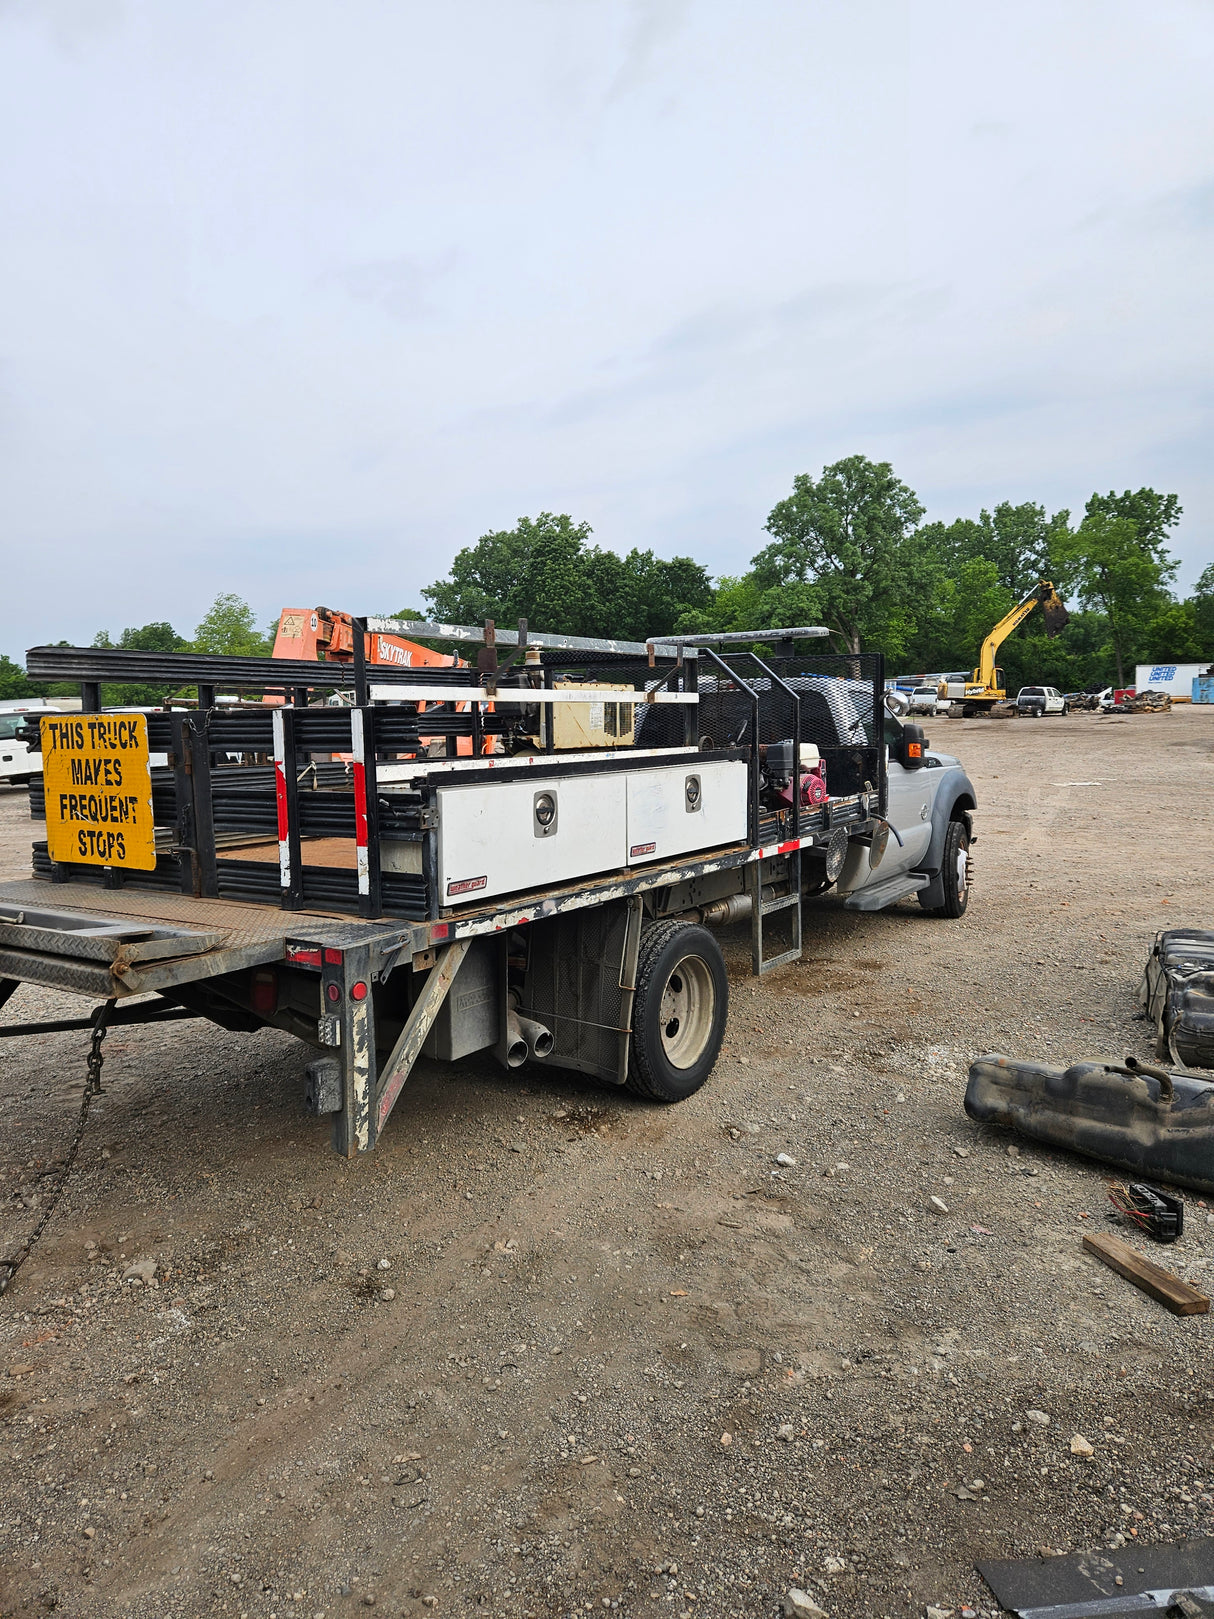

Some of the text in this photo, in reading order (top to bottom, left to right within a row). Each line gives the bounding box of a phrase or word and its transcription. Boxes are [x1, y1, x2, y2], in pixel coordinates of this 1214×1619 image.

[380, 642, 412, 667] SKYTRAK
[49, 720, 139, 750] THIS TRUCK
[71, 758, 122, 787] MAKES
[59, 793, 139, 825] FREQUENT
[78, 829, 126, 860] STOPS
